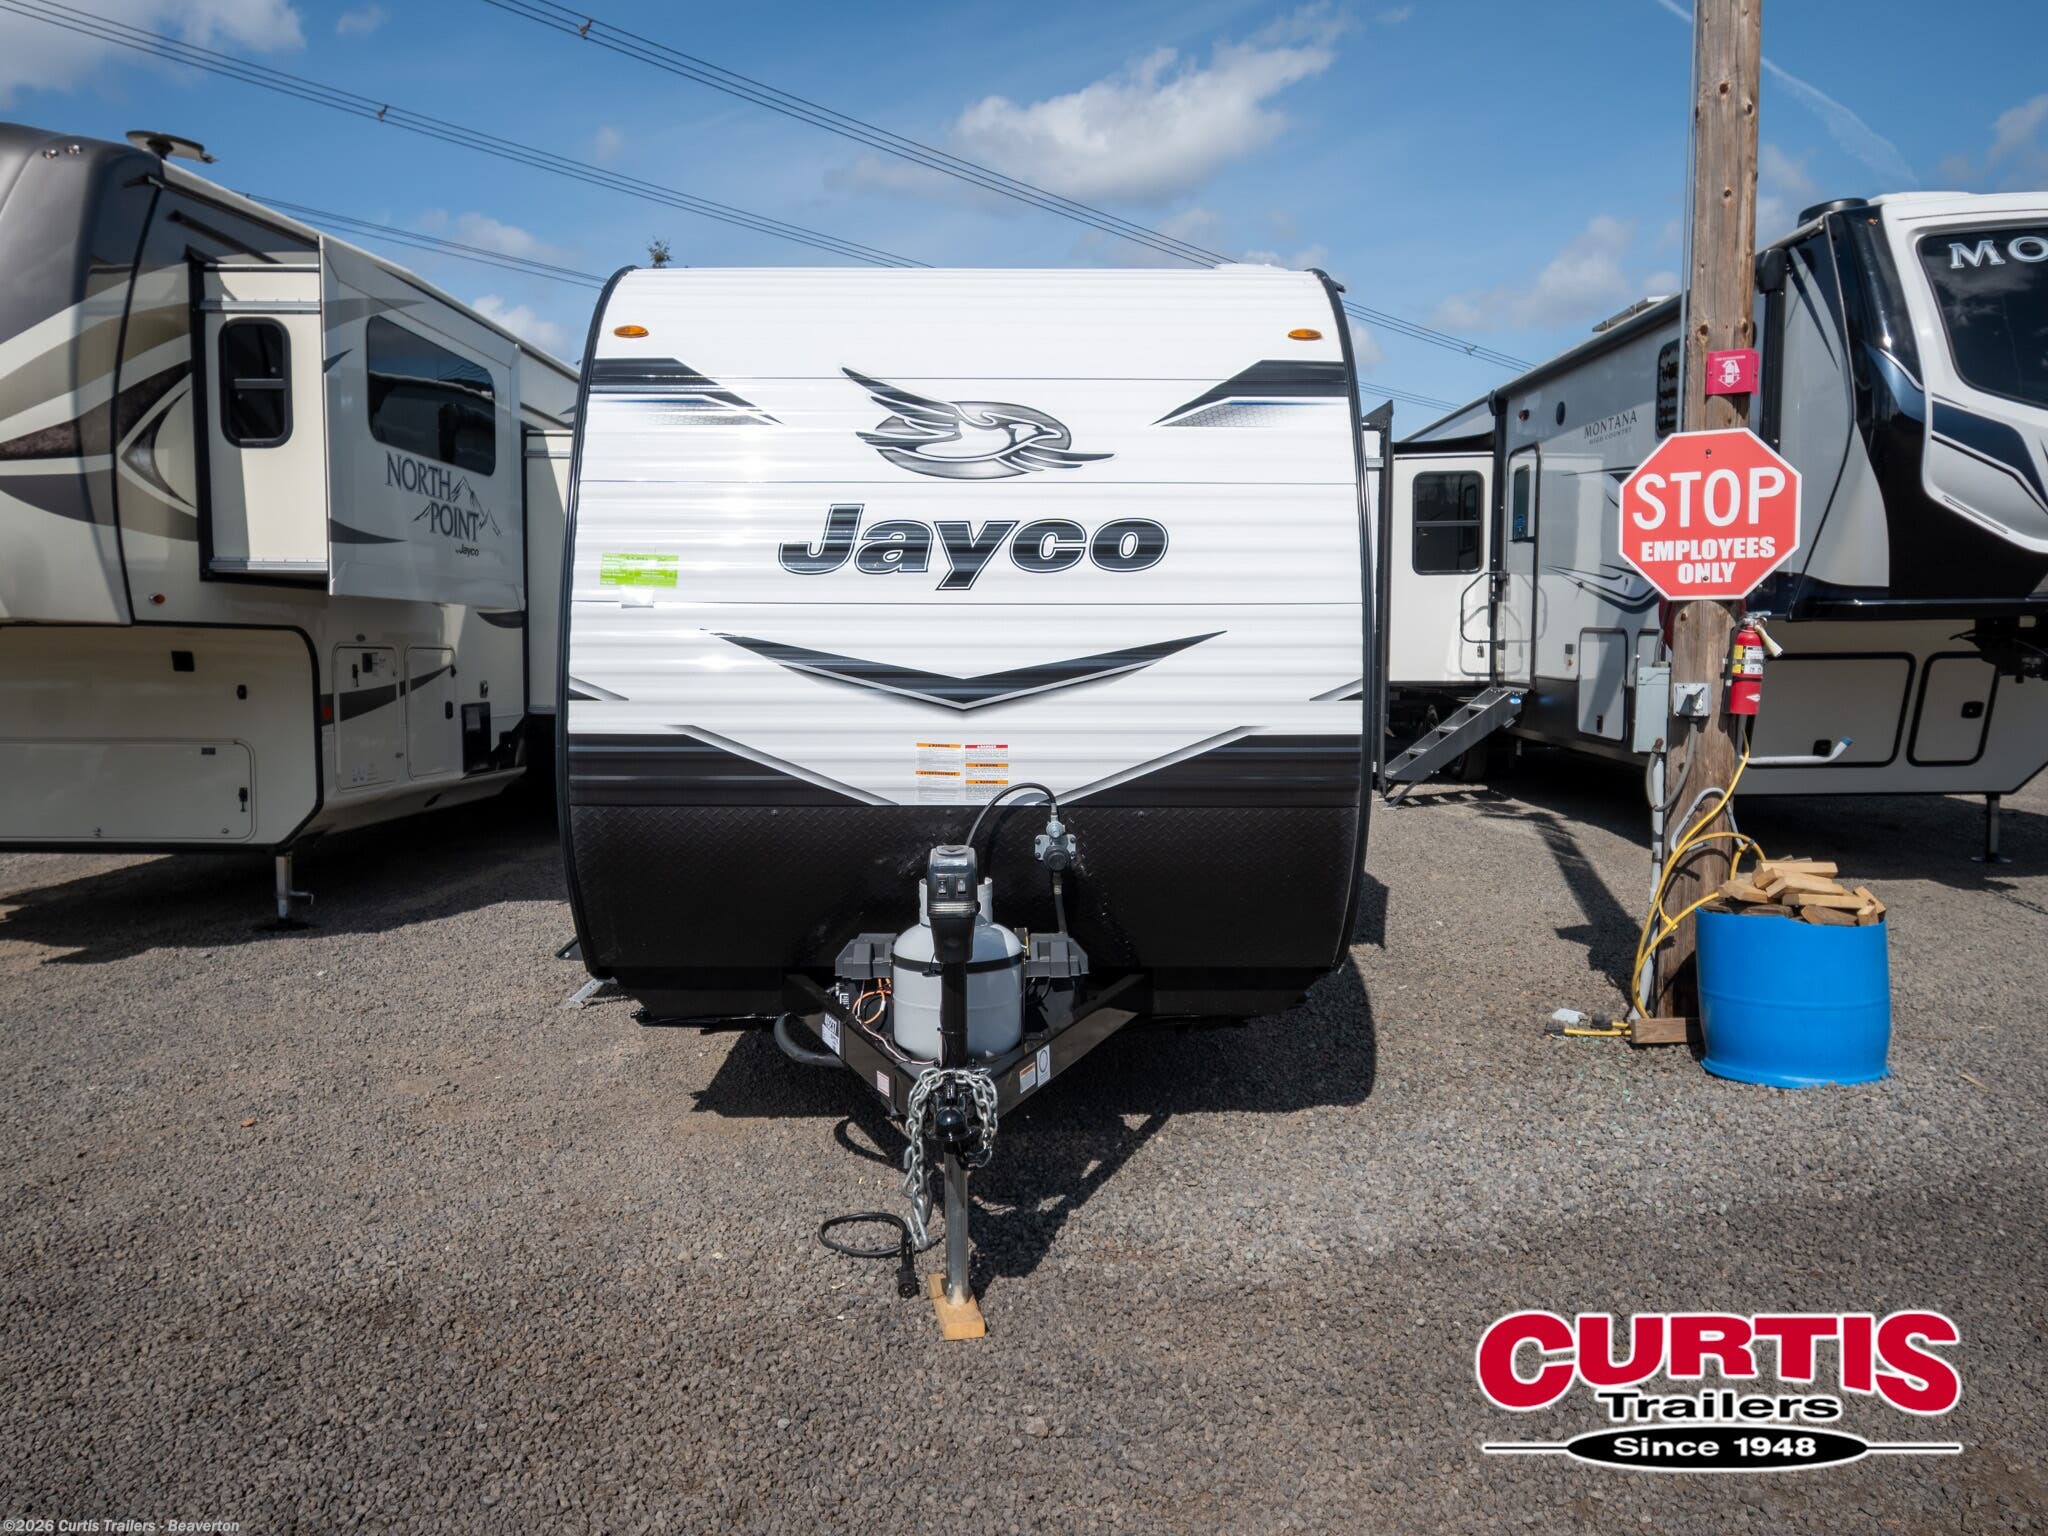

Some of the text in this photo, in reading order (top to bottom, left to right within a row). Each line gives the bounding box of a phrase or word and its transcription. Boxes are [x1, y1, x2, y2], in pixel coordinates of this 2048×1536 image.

[1584, 409, 1638, 440] MONTANA
[385, 450, 452, 503] NORTH
[1633, 466, 1786, 530] STOP
[430, 500, 479, 542] POINT
[460, 544, 480, 557] Jayco
[778, 503, 1169, 591] Jayco
[1641, 536, 1776, 562] EMPLOYEES
[1678, 562, 1737, 584] ONLY
